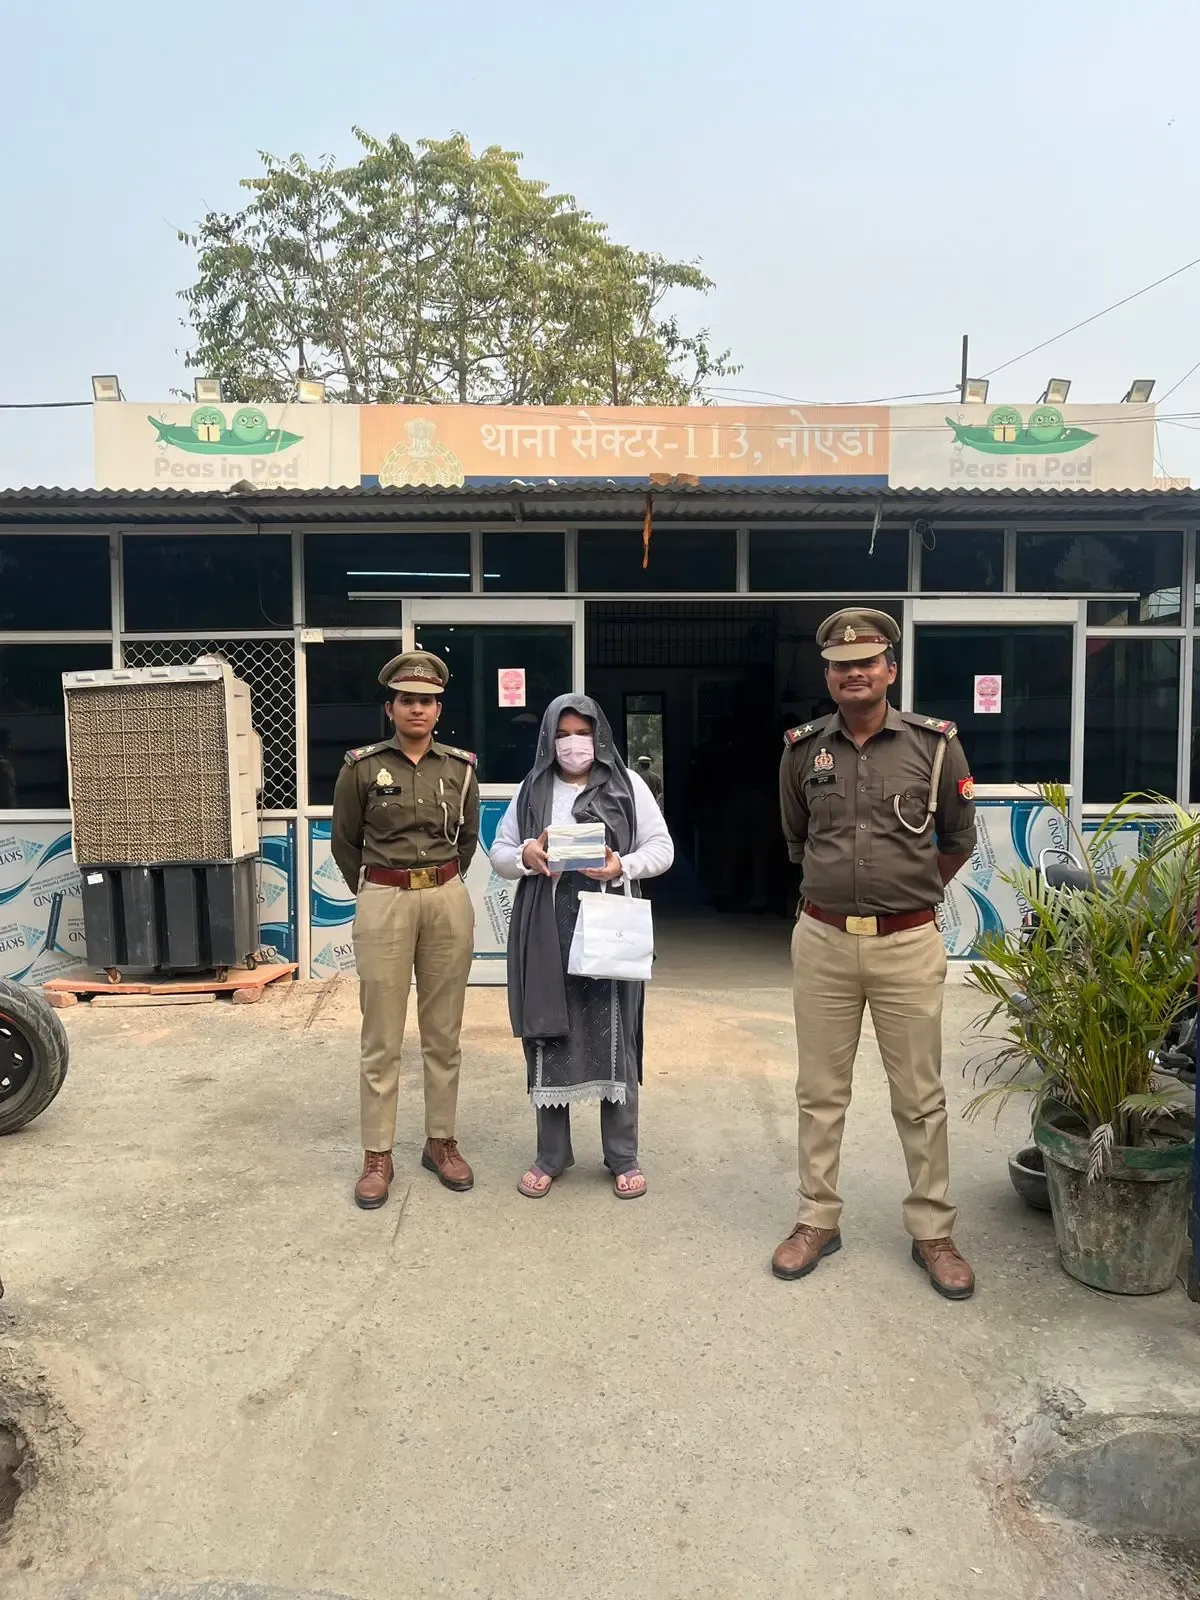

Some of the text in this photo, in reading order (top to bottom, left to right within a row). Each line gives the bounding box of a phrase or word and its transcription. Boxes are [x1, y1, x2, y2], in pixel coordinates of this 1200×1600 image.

[480, 423, 561, 459] थाना
[774, 409, 879, 464] नोएडा
[154, 456, 299, 478] Peas in Pod
[950, 456, 1092, 478] Peas in Pod
